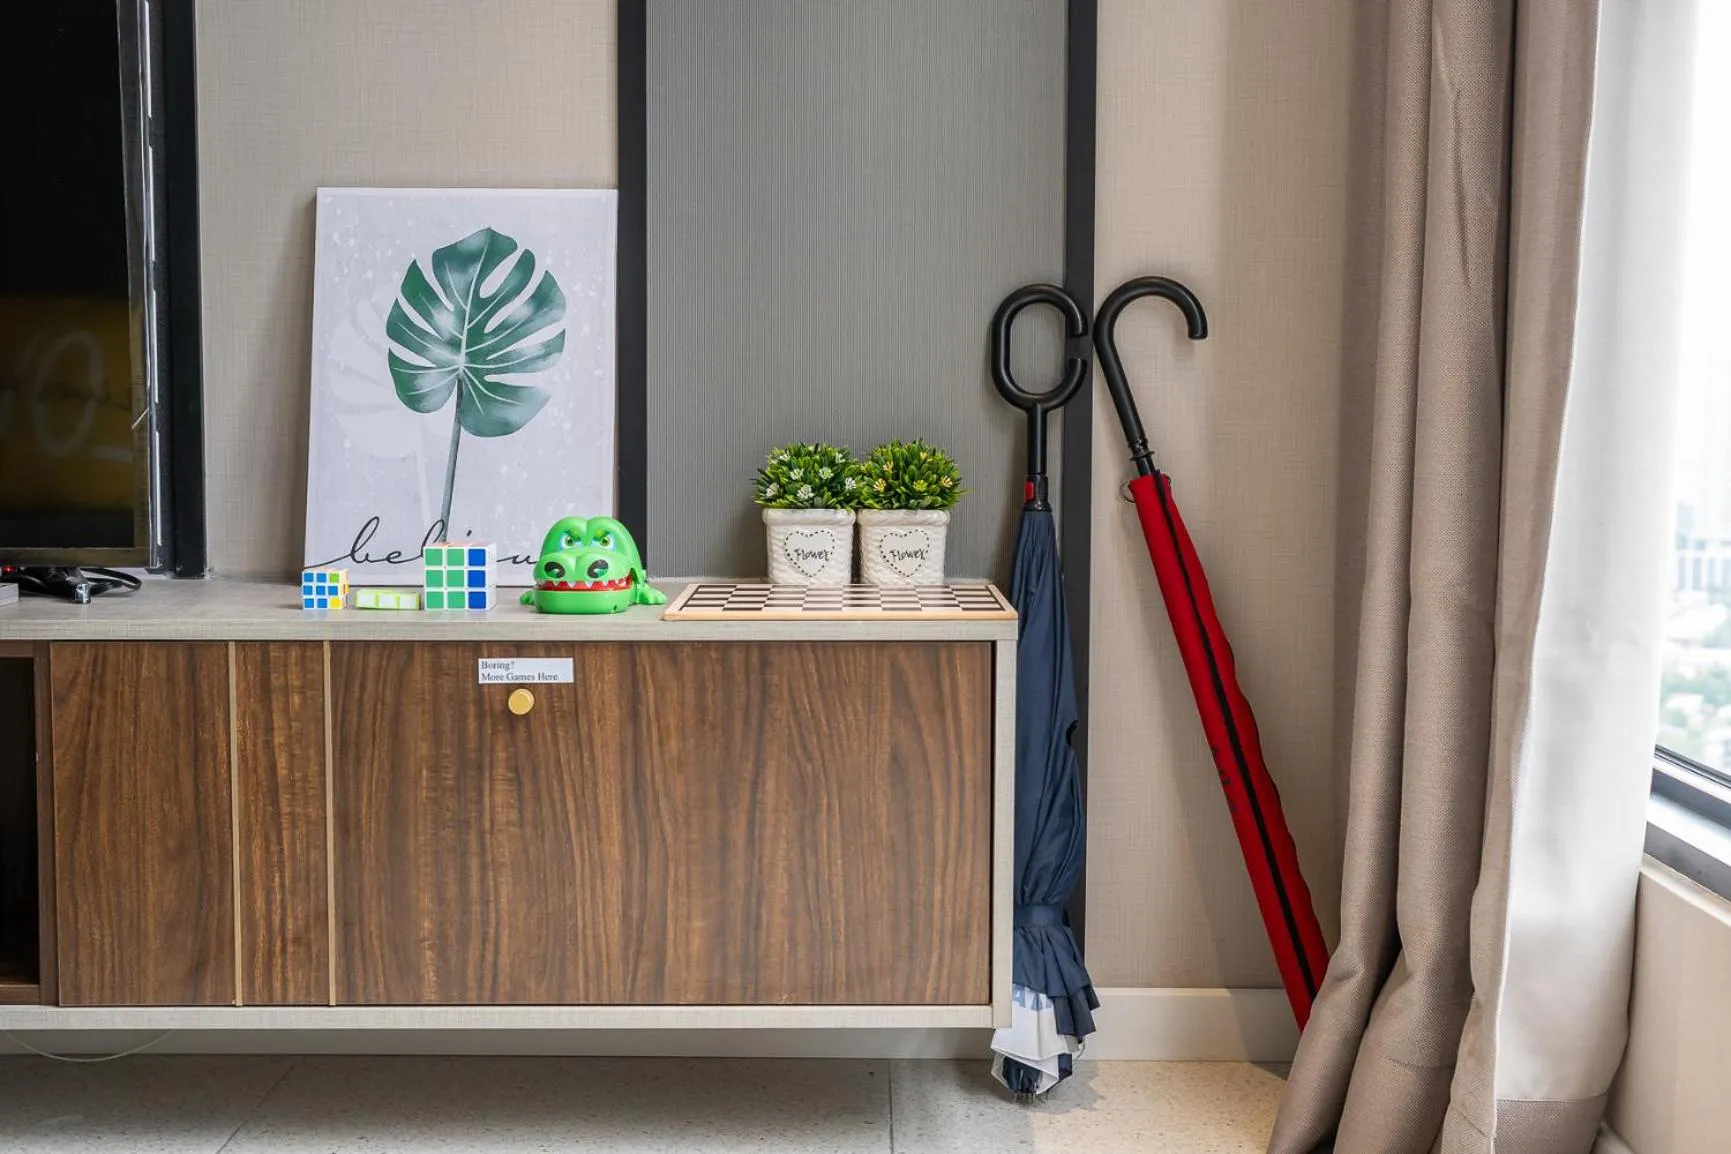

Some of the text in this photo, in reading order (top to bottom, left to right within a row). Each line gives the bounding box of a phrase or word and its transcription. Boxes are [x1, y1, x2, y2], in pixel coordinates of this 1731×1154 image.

[481, 660, 515, 672] Boring?
[481, 672, 559, 681] More Games Here
